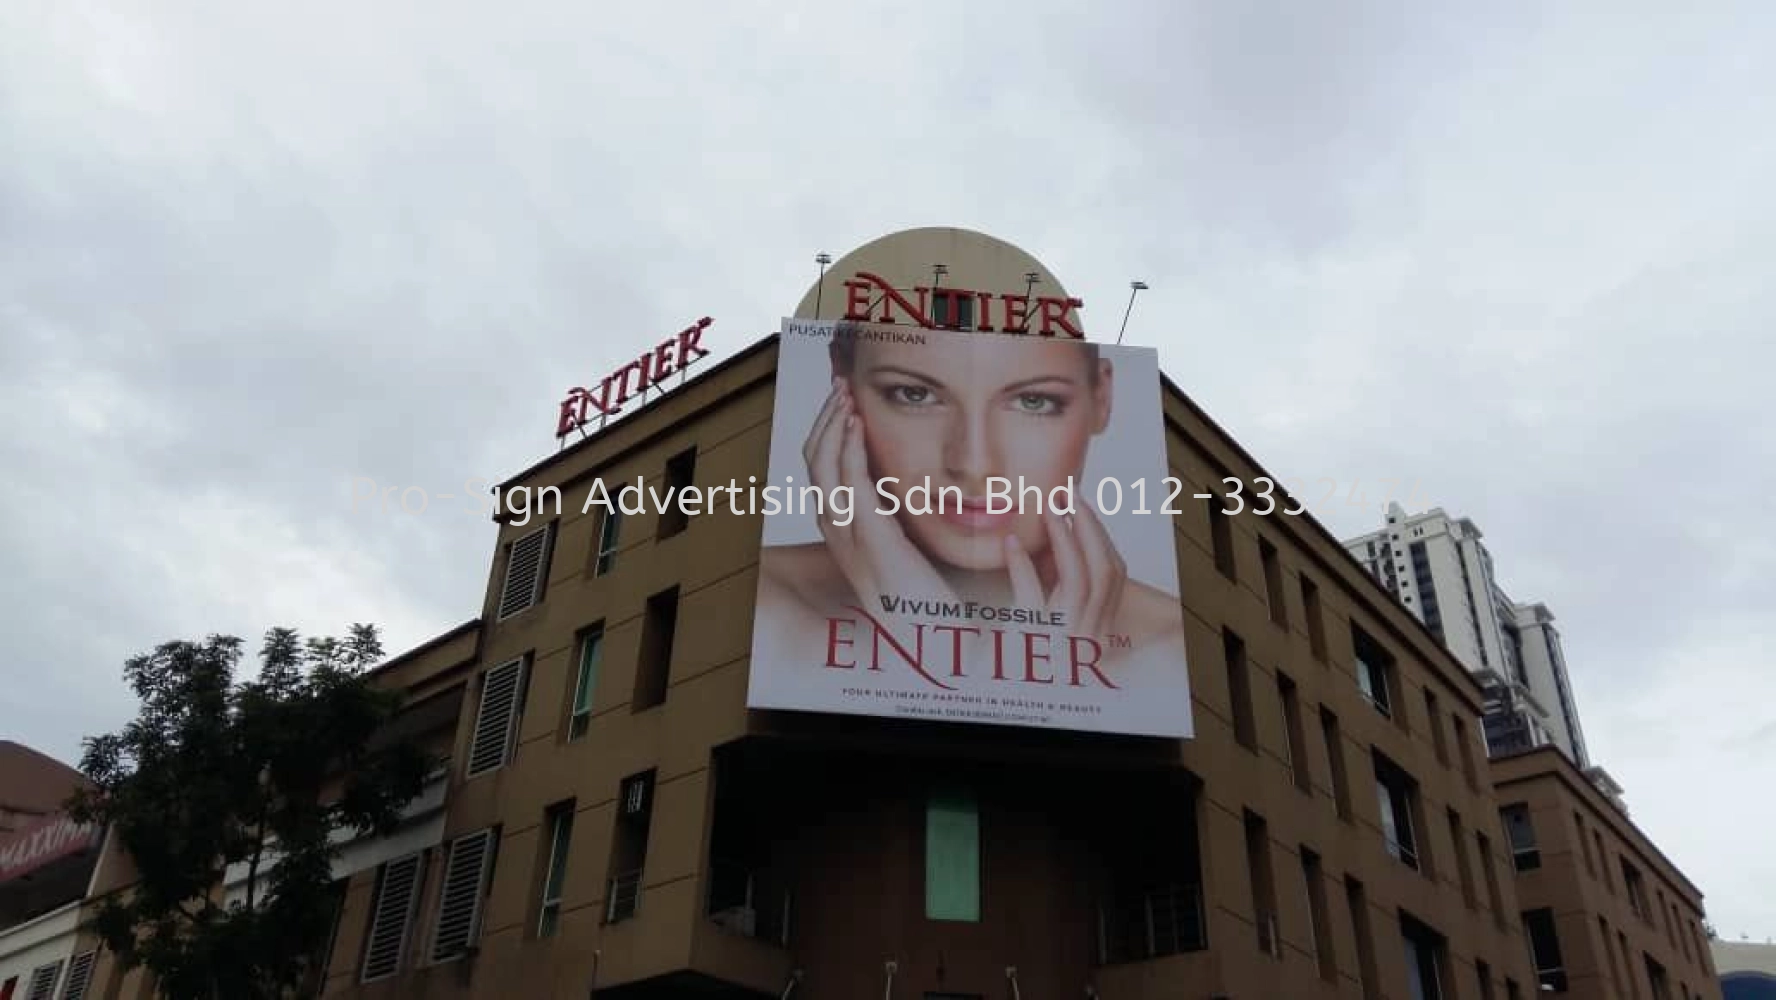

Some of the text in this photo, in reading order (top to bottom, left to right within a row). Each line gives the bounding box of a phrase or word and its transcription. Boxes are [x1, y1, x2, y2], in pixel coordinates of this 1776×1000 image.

[789, 323, 832, 337] PUSAT
[844, 271, 1084, 339] ENTIER
[556, 320, 710, 438] ENTIER
[825, 605, 1121, 690] ENTIER
